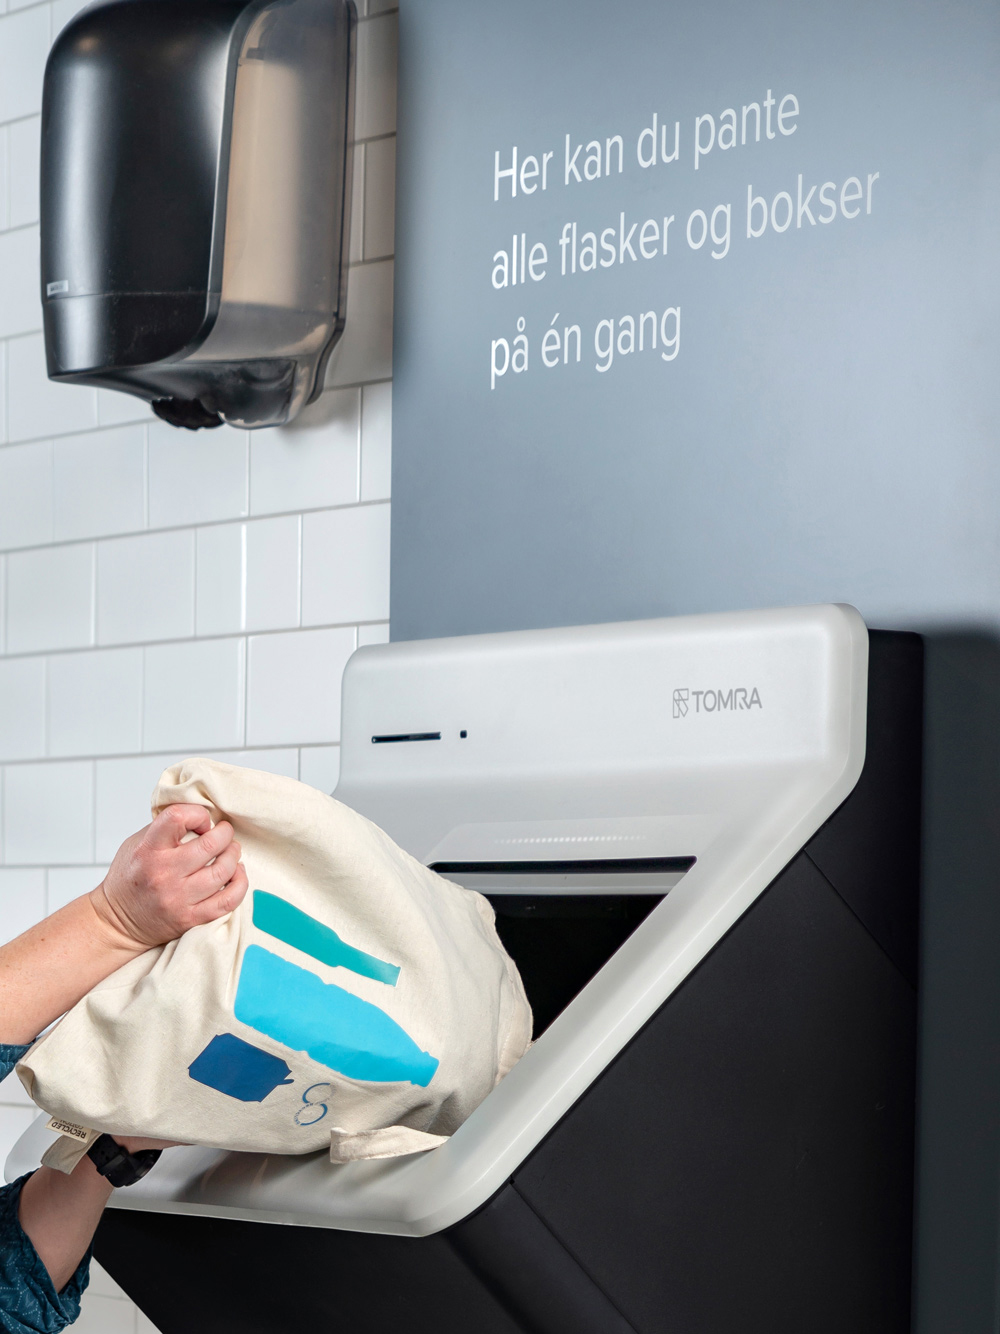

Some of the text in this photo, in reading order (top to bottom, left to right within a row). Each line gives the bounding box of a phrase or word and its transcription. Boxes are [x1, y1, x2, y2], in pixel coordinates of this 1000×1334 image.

[494, 89, 799, 201] Her kan du pante
[492, 172, 879, 289] alle flasker og bokser
[491, 307, 680, 390] på én gang
[691, 687, 763, 713] TOMRA
[51, 1121, 87, 1139] RECYCLED
